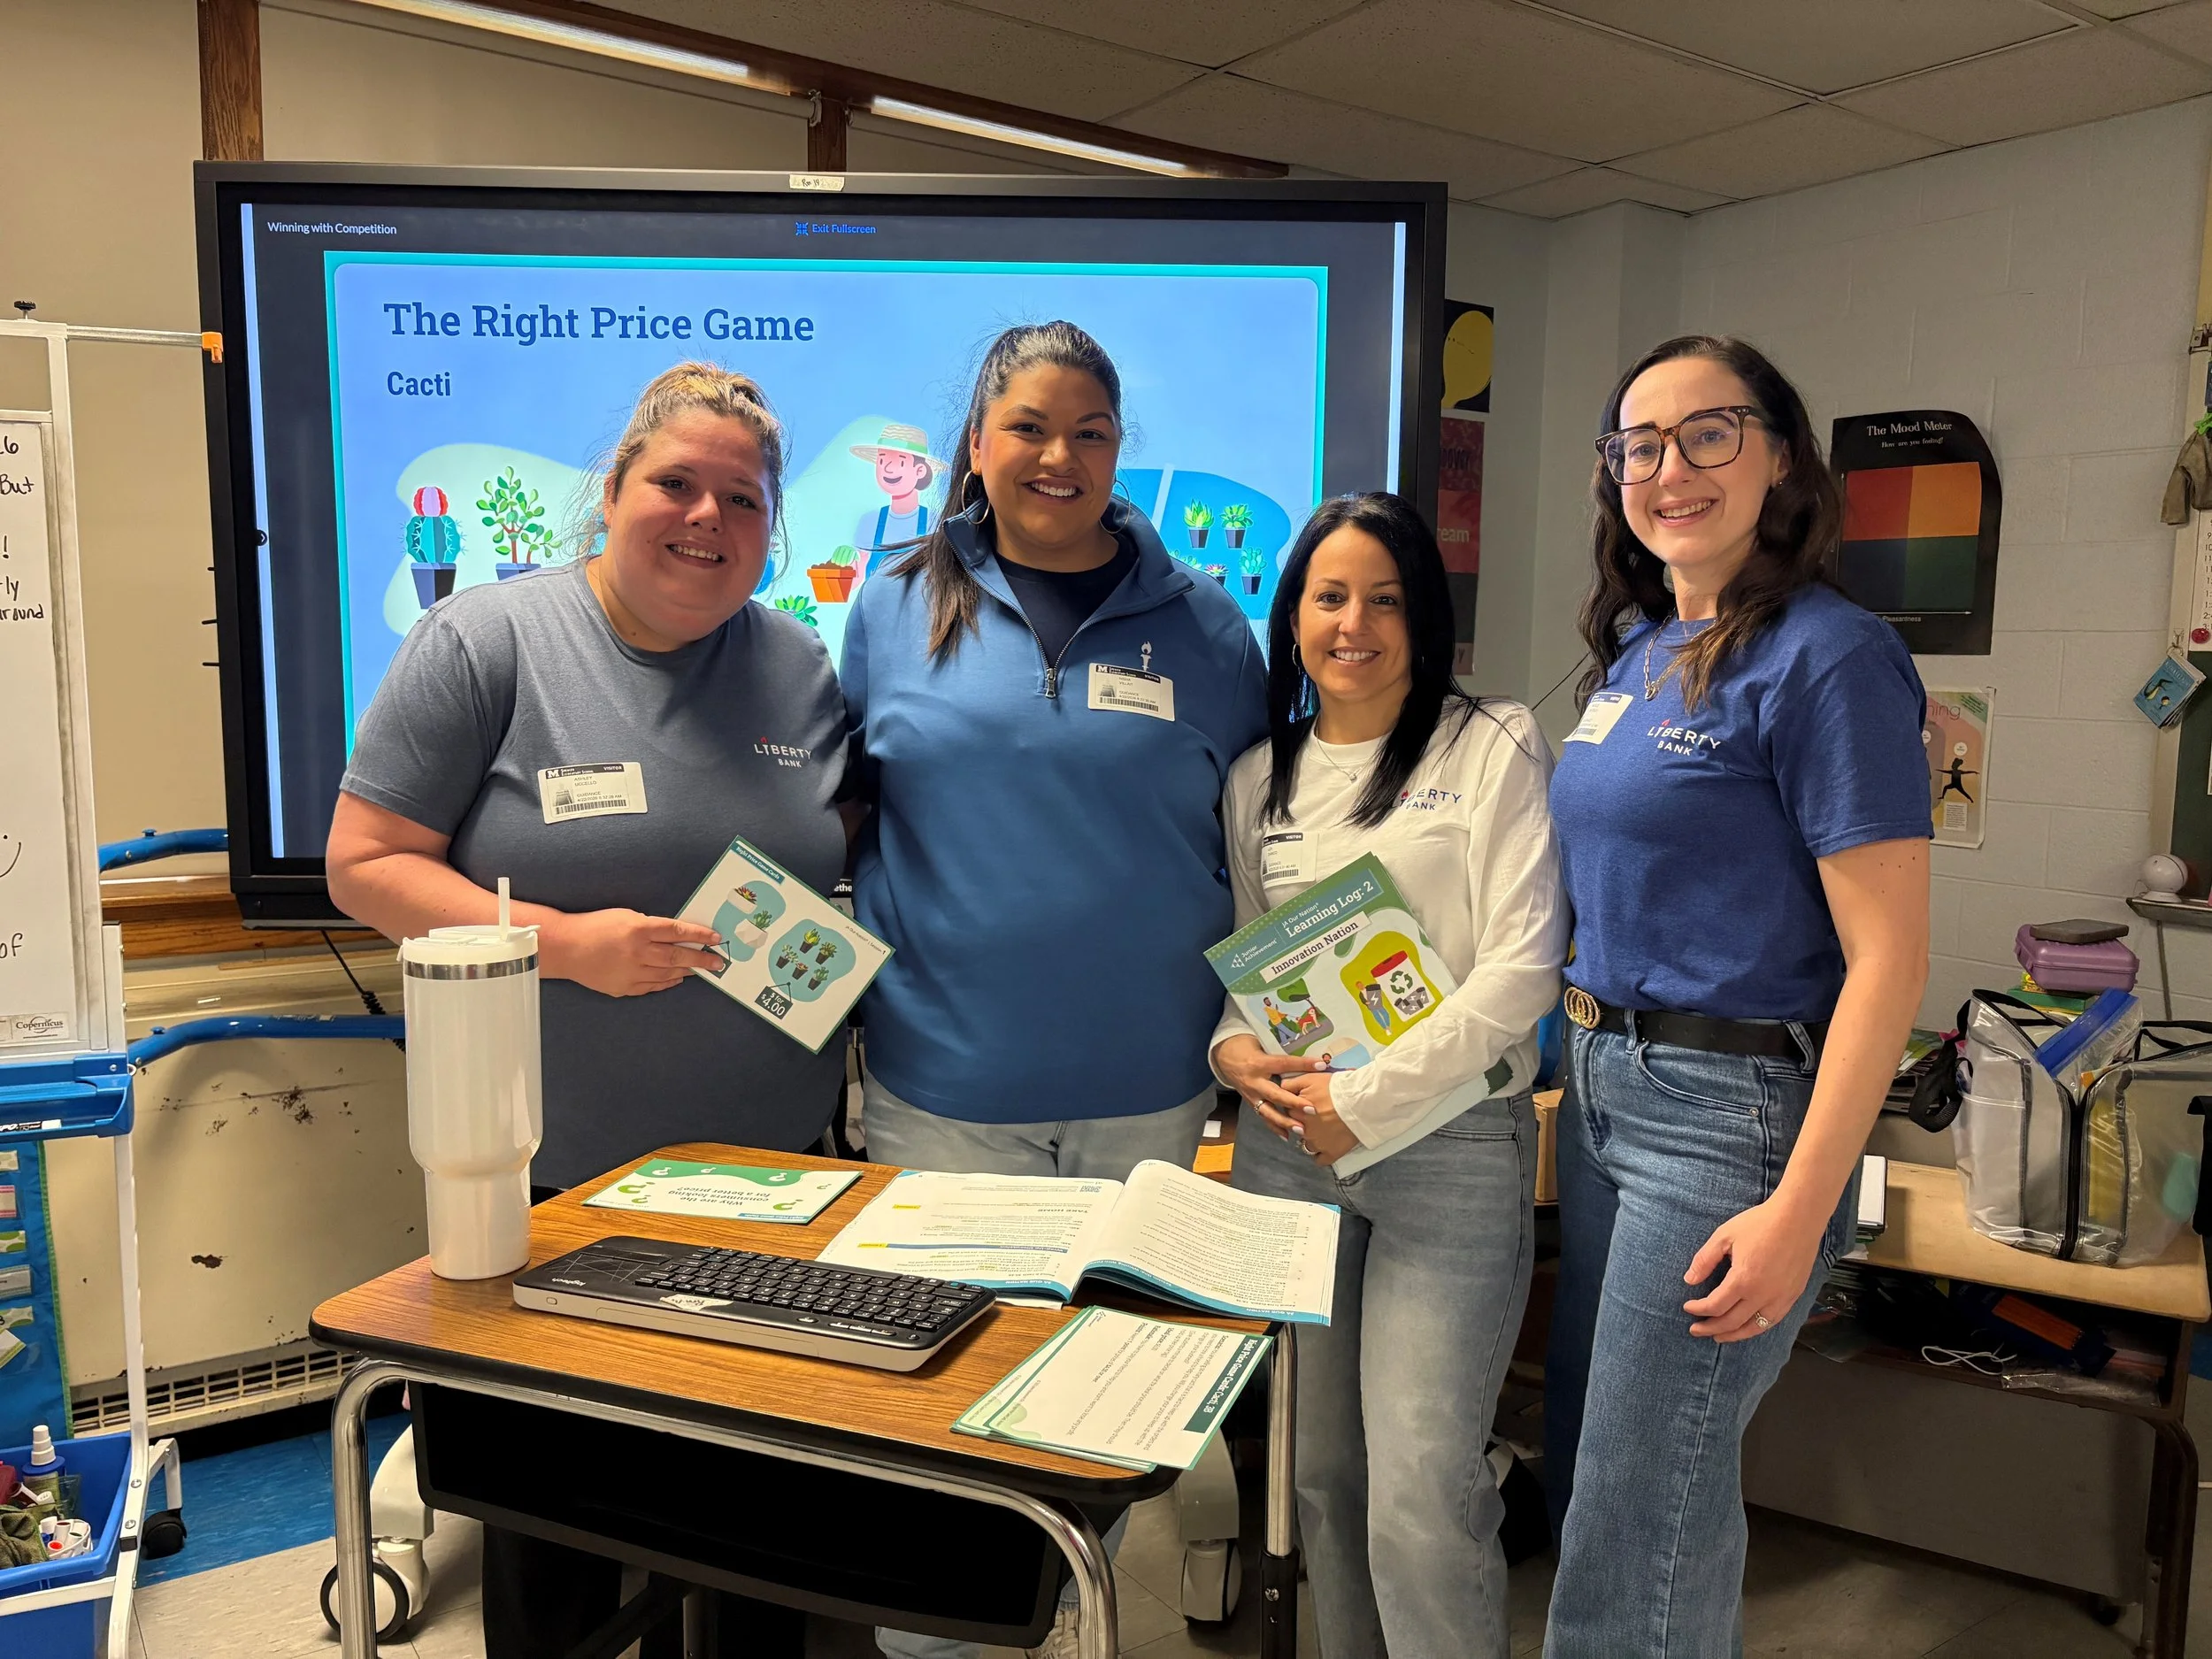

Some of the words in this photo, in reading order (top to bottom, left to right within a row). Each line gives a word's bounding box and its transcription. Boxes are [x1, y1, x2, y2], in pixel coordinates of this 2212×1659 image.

[267, 222, 310, 234] Winning
[311, 223, 334, 233] with
[335, 223, 397, 234] Competition
[812, 224, 829, 234] Exit
[832, 225, 876, 234] Fullscreen
[384, 302, 460, 336] The
[472, 303, 580, 347] Right
[590, 306, 692, 340] Price
[703, 308, 814, 342] Game
[388, 371, 450, 396] Cacti
[1867, 425, 1886, 436] The
[1890, 420, 1921, 434] Mood
[1924, 420, 1953, 432] Meter
[1647, 726, 1722, 750] LIBERTY
[754, 742, 812, 761] LIBERTY
[1656, 740, 1694, 757] BANK
[778, 758, 803, 769] BANK
[1285, 902, 1340, 938] Learning
[1336, 886, 1366, 909] Log:
[1363, 880, 1374, 893] 2
[1241, 946, 1257, 958] Junior
[1271, 941, 1324, 975] Innovation
[1322, 920, 1359, 950] Nation
[762, 993, 786, 1018] $4.00
[775, 994, 784, 1004] for
[16, 1018, 64, 1031] Copernicus
[668, 1190, 709, 1199] looking
[551, 1276, 587, 1287] logitech
[1242, 1338, 1259, 1352] Right
[1235, 1350, 1252, 1363] Price
[1225, 1363, 1243, 1377] Game
[1206, 1390, 1226, 1406] Cacti,
[1202, 1404, 1216, 1413] 3B
